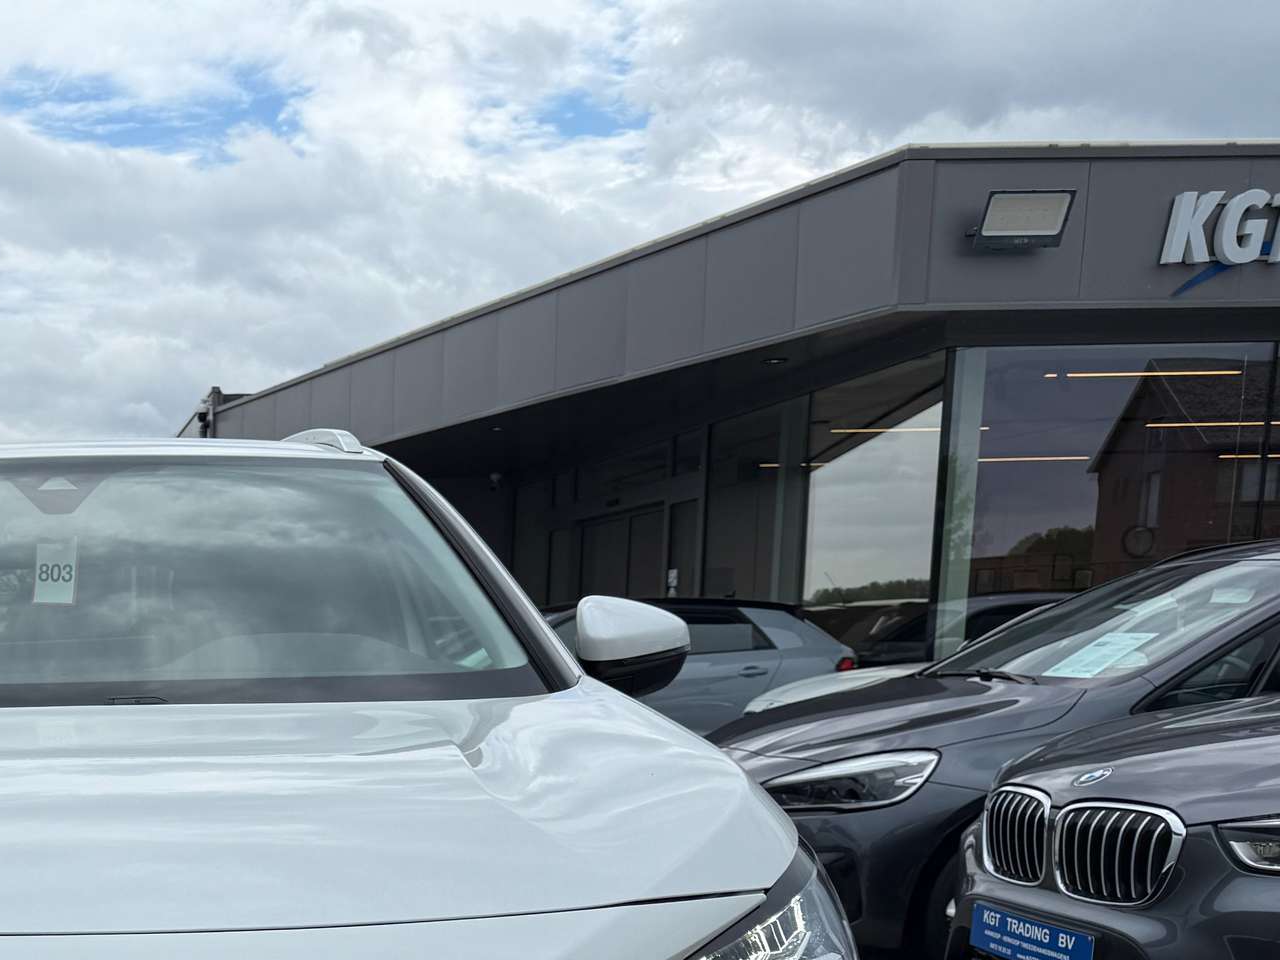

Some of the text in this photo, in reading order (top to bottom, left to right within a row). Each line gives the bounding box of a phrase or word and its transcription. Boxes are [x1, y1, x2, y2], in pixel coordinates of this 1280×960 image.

[1160, 188, 1280, 265] KG
[38, 563, 73, 582] 803
[983, 909, 1001, 927] KGT
[1006, 917, 1050, 943] TRADING
[1058, 933, 1075, 950] BV
